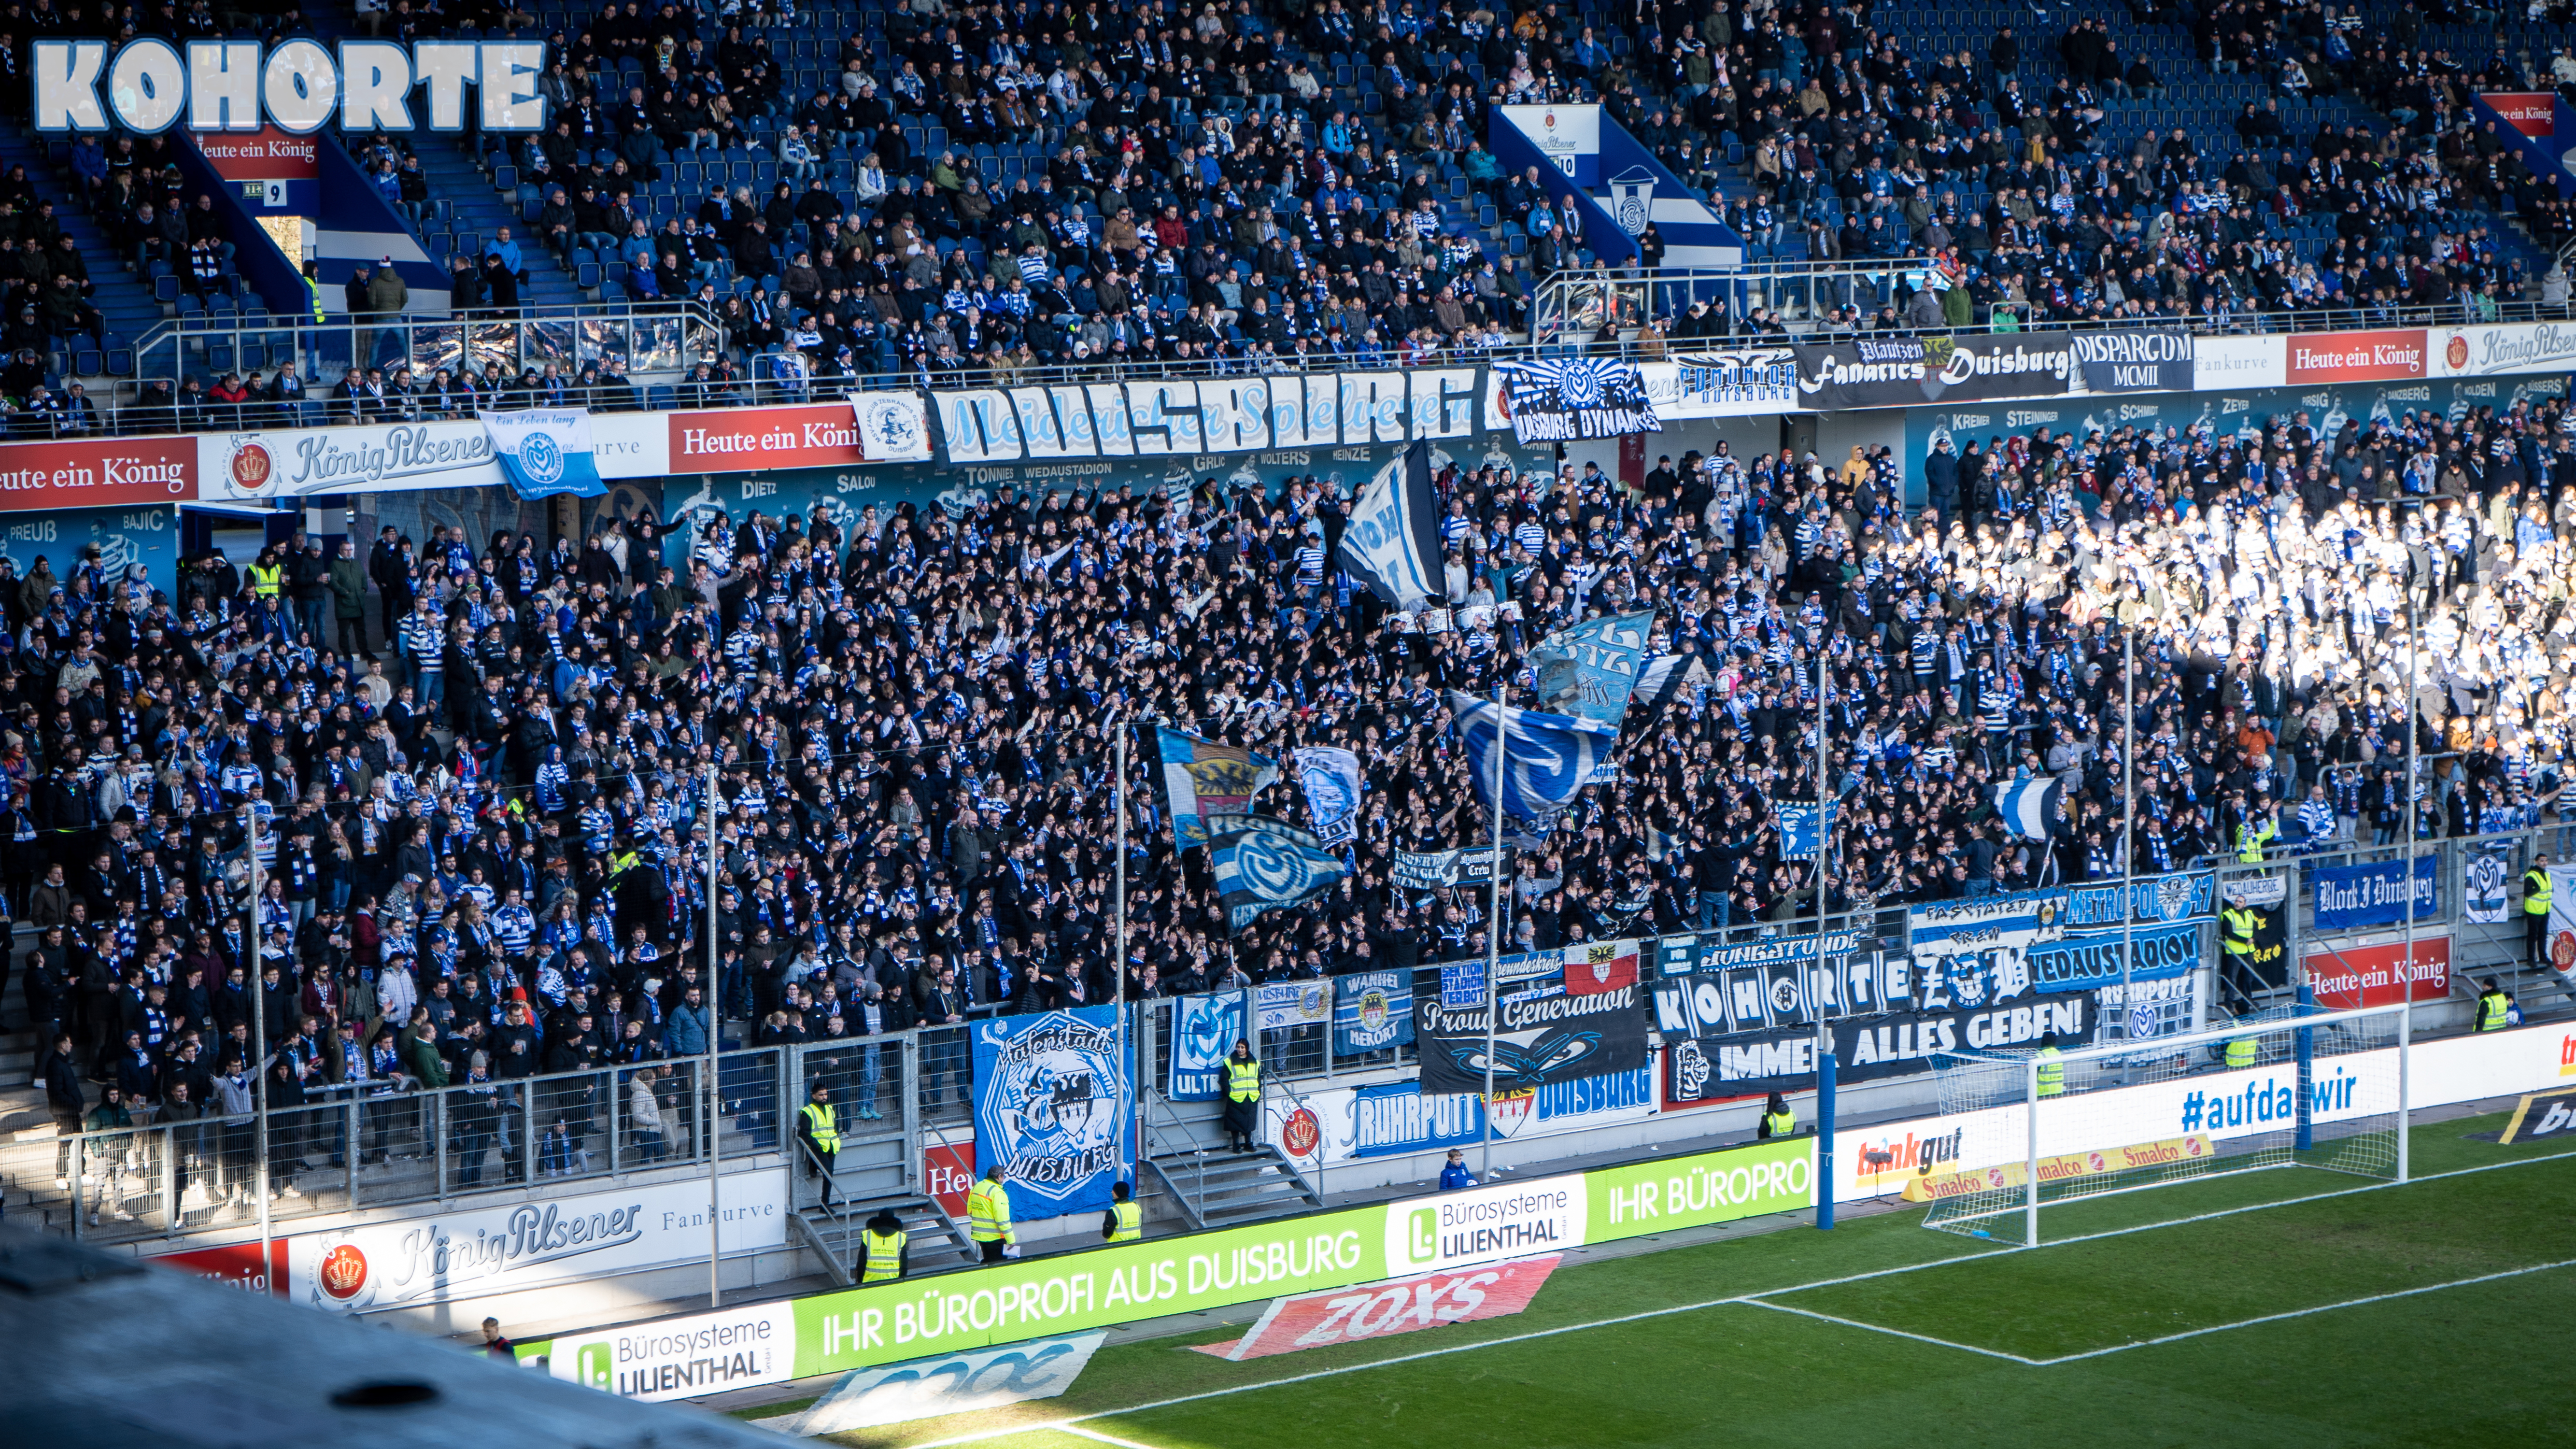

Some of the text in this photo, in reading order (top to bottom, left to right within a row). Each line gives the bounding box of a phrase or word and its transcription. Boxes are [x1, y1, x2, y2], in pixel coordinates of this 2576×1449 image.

[2510, 107, 2523, 120] ein
[2526, 107, 2552, 124] König
[240, 142, 266, 158] ein
[268, 139, 315, 163] König
[270, 185, 280, 202] 9
[1858, 340, 1924, 364] Plautzen
[2074, 333, 2192, 362] DISPARGUM
[2295, 349, 2343, 369] Heute
[2346, 347, 2369, 367] ein
[2374, 344, 2420, 372] König
[2480, 331, 2534, 366] König
[1799, 344, 2069, 393] Fanatics Duisburg
[2114, 365, 2158, 386] MCMII
[2302, 392, 2329, 408] PIRSIG
[2388, 385, 2431, 402] DANZBERG
[2463, 382, 2496, 398] NOLDEN
[2120, 405, 2158, 421] SCHMIDT
[2222, 398, 2250, 414] ZEYER
[496, 415, 576, 427] Ein Leben lang
[1953, 413, 1990, 431] KREMER
[2007, 410, 2058, 427] STEININGER
[684, 428, 753, 455] Heute
[760, 431, 796, 450] ein
[889, 439, 918, 453] DUISBURG
[291, 435, 384, 484] König
[1260, 451, 1310, 465] WOLTERS
[1332, 446, 1371, 462] HEINZE
[53, 461, 94, 486] ein
[103, 457, 184, 493] König
[1025, 463, 1112, 479] WEDAUSTADION
[741, 480, 777, 499] DIETZ
[837, 474, 876, 494] SALOU
[123, 510, 164, 531] BAJIC
[2191, 873, 2215, 913] 47
[2320, 881, 2358, 913] Block
[1496, 952, 1564, 977] reundeskreis
[1347, 973, 1398, 994] WANHEI
[2307, 971, 2358, 996] Heute
[2362, 966, 2388, 987] ein
[1504, 984, 1635, 1030] Generation
[1852, 1018, 1955, 1065] ALLES
[1967, 999, 2082, 1049] GEBEN!
[1358, 1093, 1478, 1148] RUHRPOTT
[2124, 1143, 2179, 1167] Sinalco
[1923, 1173, 1981, 1199] Sinalco
[1443, 1189, 1567, 1227] Bürosysteme
[1610, 1183, 1658, 1224] IHR
[393, 1225, 506, 1286] König
[507, 1204, 641, 1259] Pilsener
[1443, 1219, 1559, 1259] LILIENTHAL
[823, 1231, 1360, 1356] IHR BÜROPROFI AUS DUISBURG
[619, 1319, 771, 1363] Bürosysteme
[619, 1351, 762, 1397] LILIENTHAL
